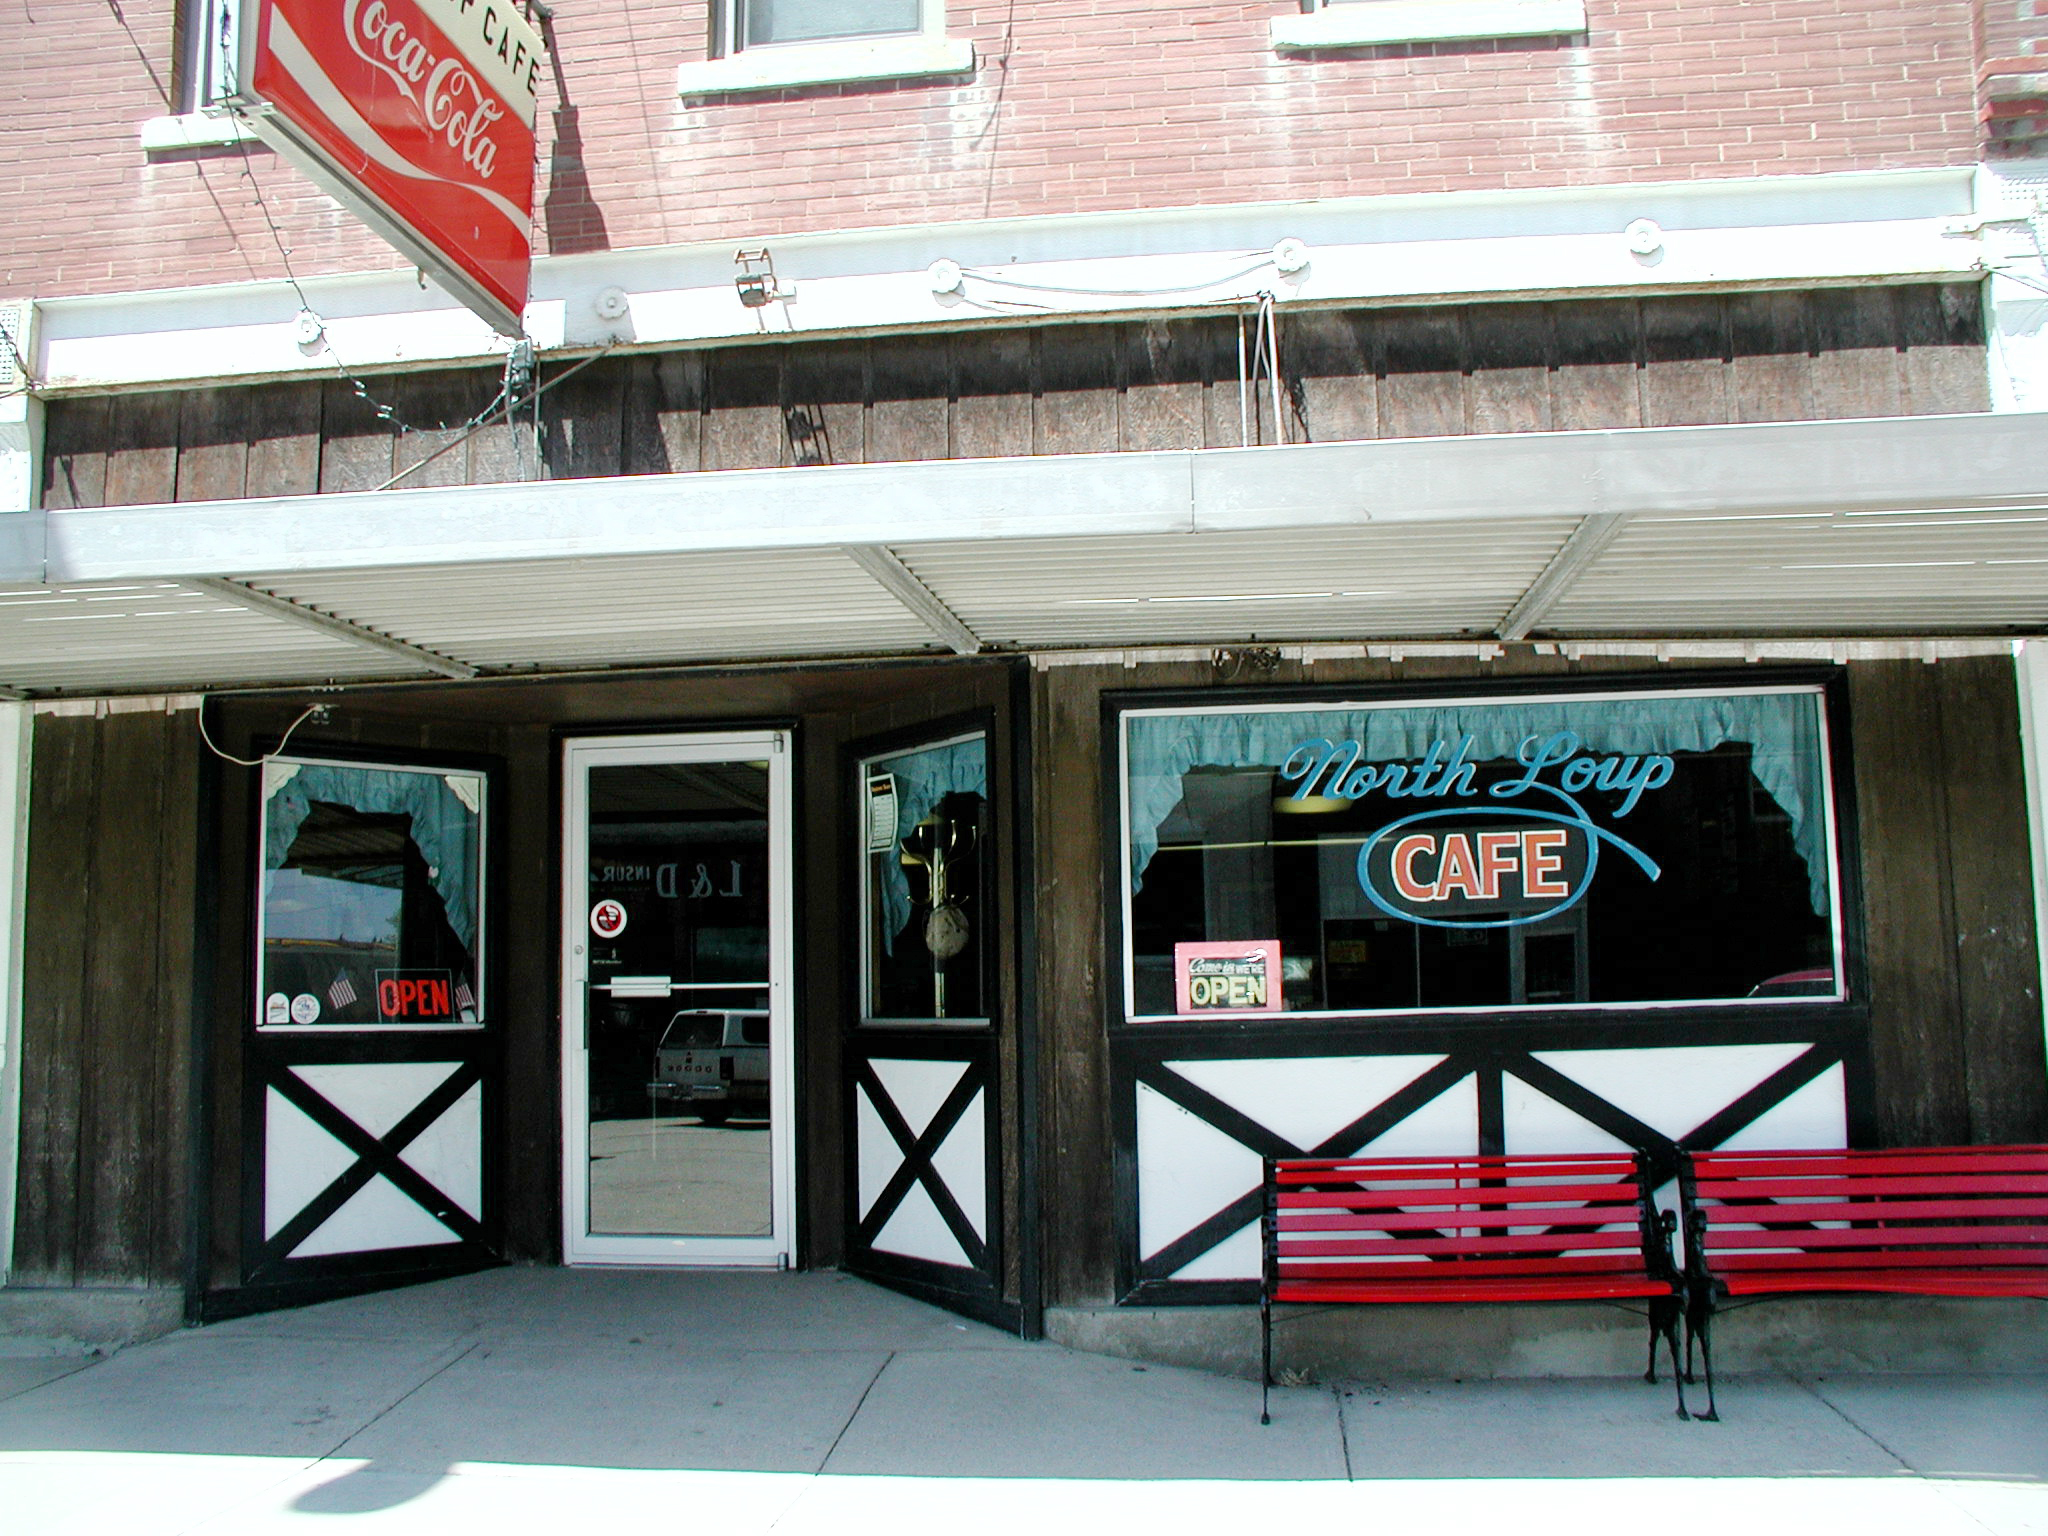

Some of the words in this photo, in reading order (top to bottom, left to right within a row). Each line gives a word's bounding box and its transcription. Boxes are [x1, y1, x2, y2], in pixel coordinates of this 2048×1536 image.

[483, 6, 540, 97] CAFE
[1281, 734, 1478, 800] North
[1489, 731, 1675, 818] Loup
[1390, 829, 1569, 902] CAFE
[1189, 957, 1222, 973] Come
[1190, 975, 1267, 1005] OPEN
[379, 979, 450, 1016] OPEN
